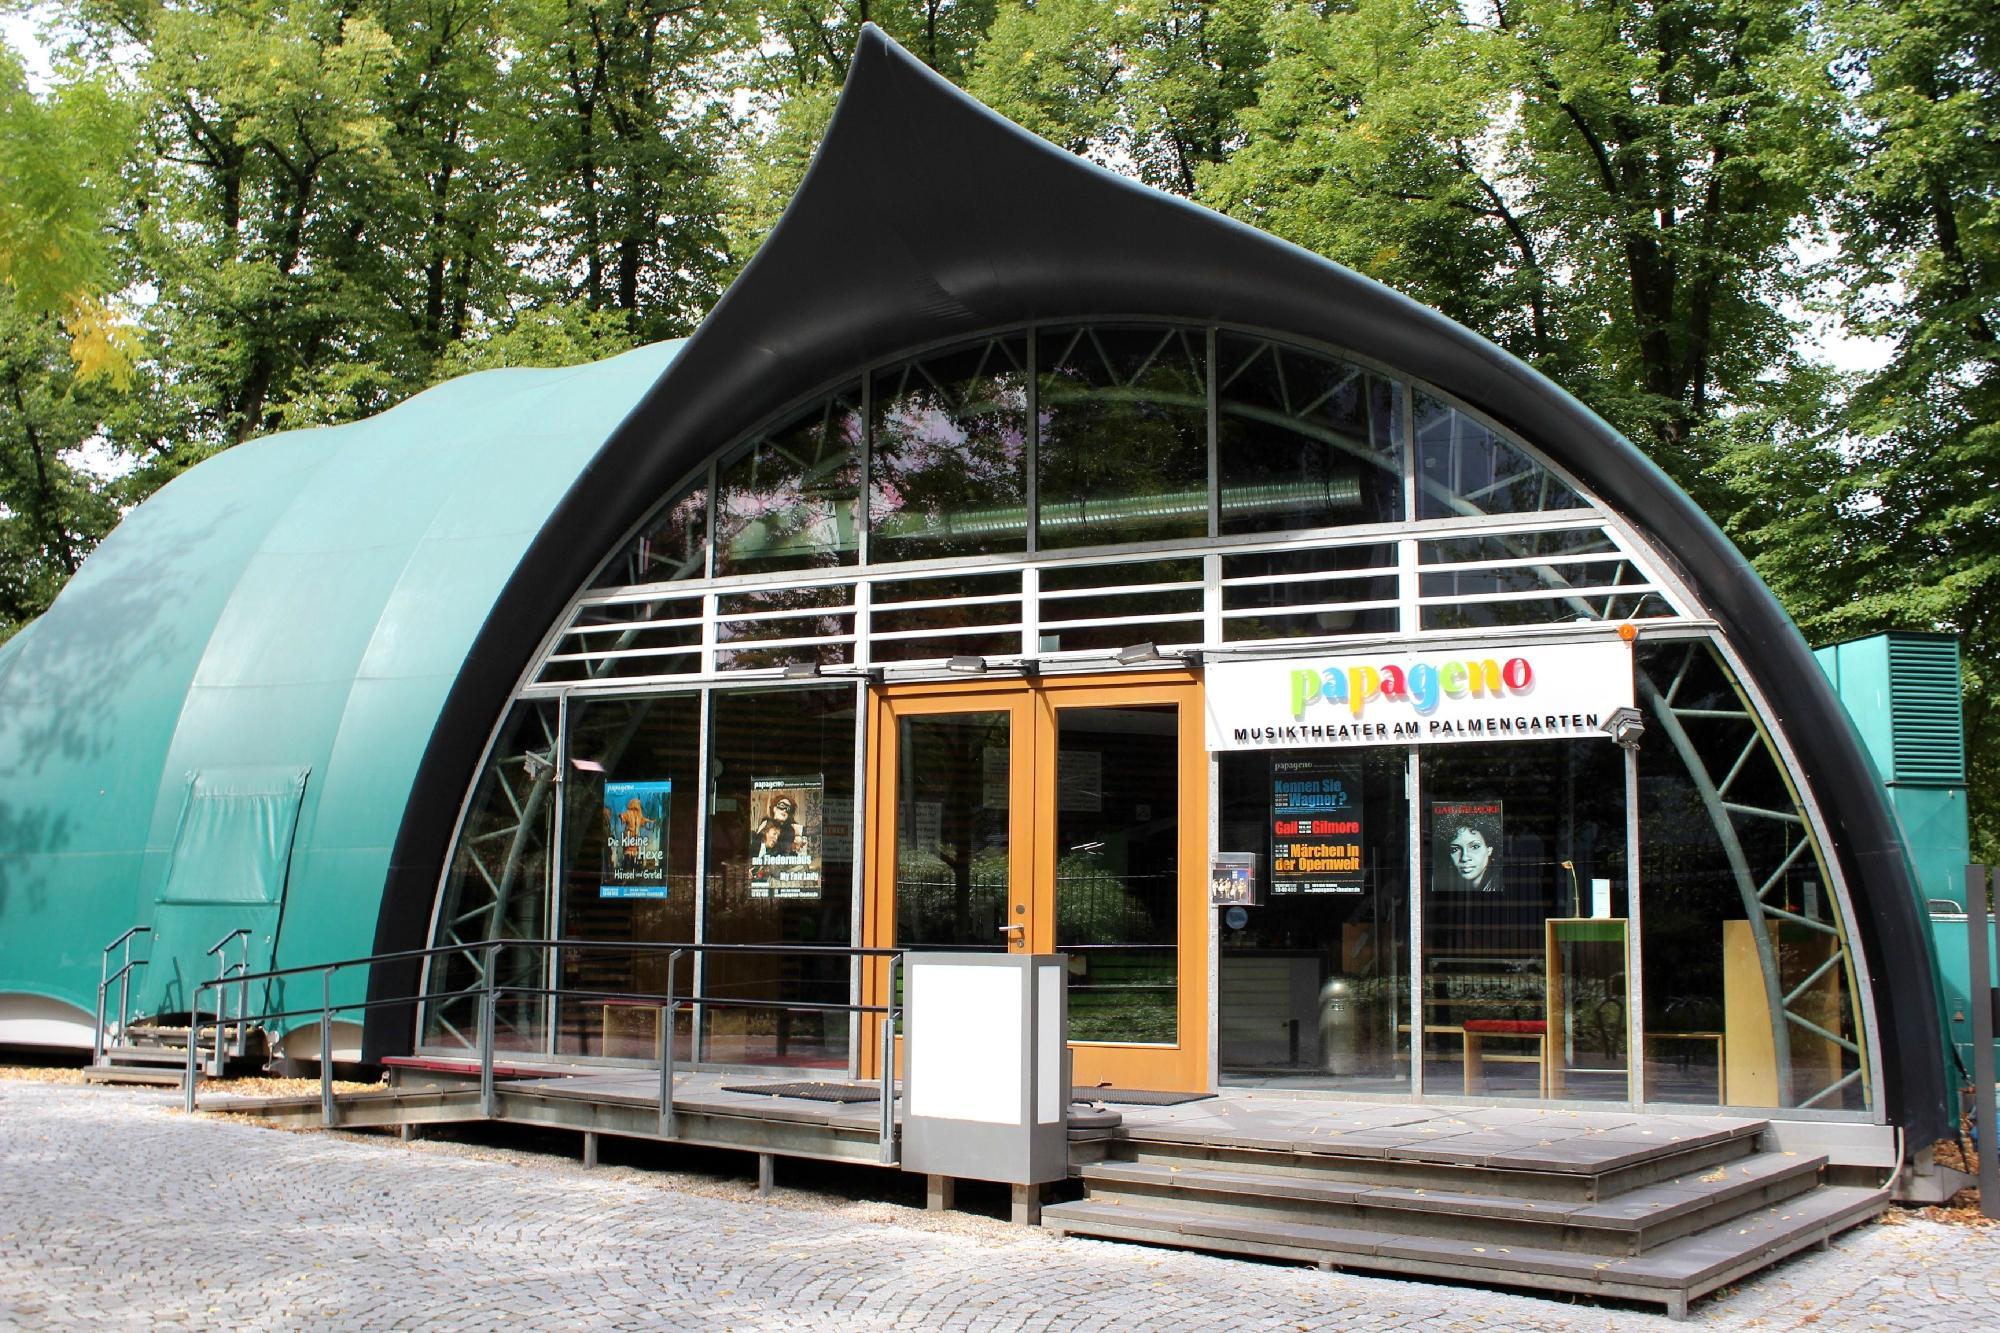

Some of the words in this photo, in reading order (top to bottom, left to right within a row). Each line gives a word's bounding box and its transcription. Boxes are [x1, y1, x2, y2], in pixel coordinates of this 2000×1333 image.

[1290, 657, 1534, 716] papageno
[1234, 722, 1387, 741] MUSIKTHEATER
[1393, 721, 1419, 735] AM
[1429, 713, 1599, 733] PALMENGARTEN
[1274, 780, 1320, 793] Kennen
[1322, 778, 1342, 792] Sie
[1275, 820, 1298, 834] Gail
[1312, 820, 1360, 834] Gilmore
[638, 846, 663, 861] Hexe
[1290, 843, 1345, 857] Märchen
[1347, 843, 1360, 857] in
[763, 854, 812, 865] Fledermaus
[1275, 858, 1296, 870] der
[1298, 857, 1360, 871] Opernwelt
[614, 868, 635, 880] Hänsel
[643, 869, 663, 880] Gretel
[780, 872, 790, 881] My
[790, 872, 803, 880] Fair
[804, 871, 819, 881] Lady
